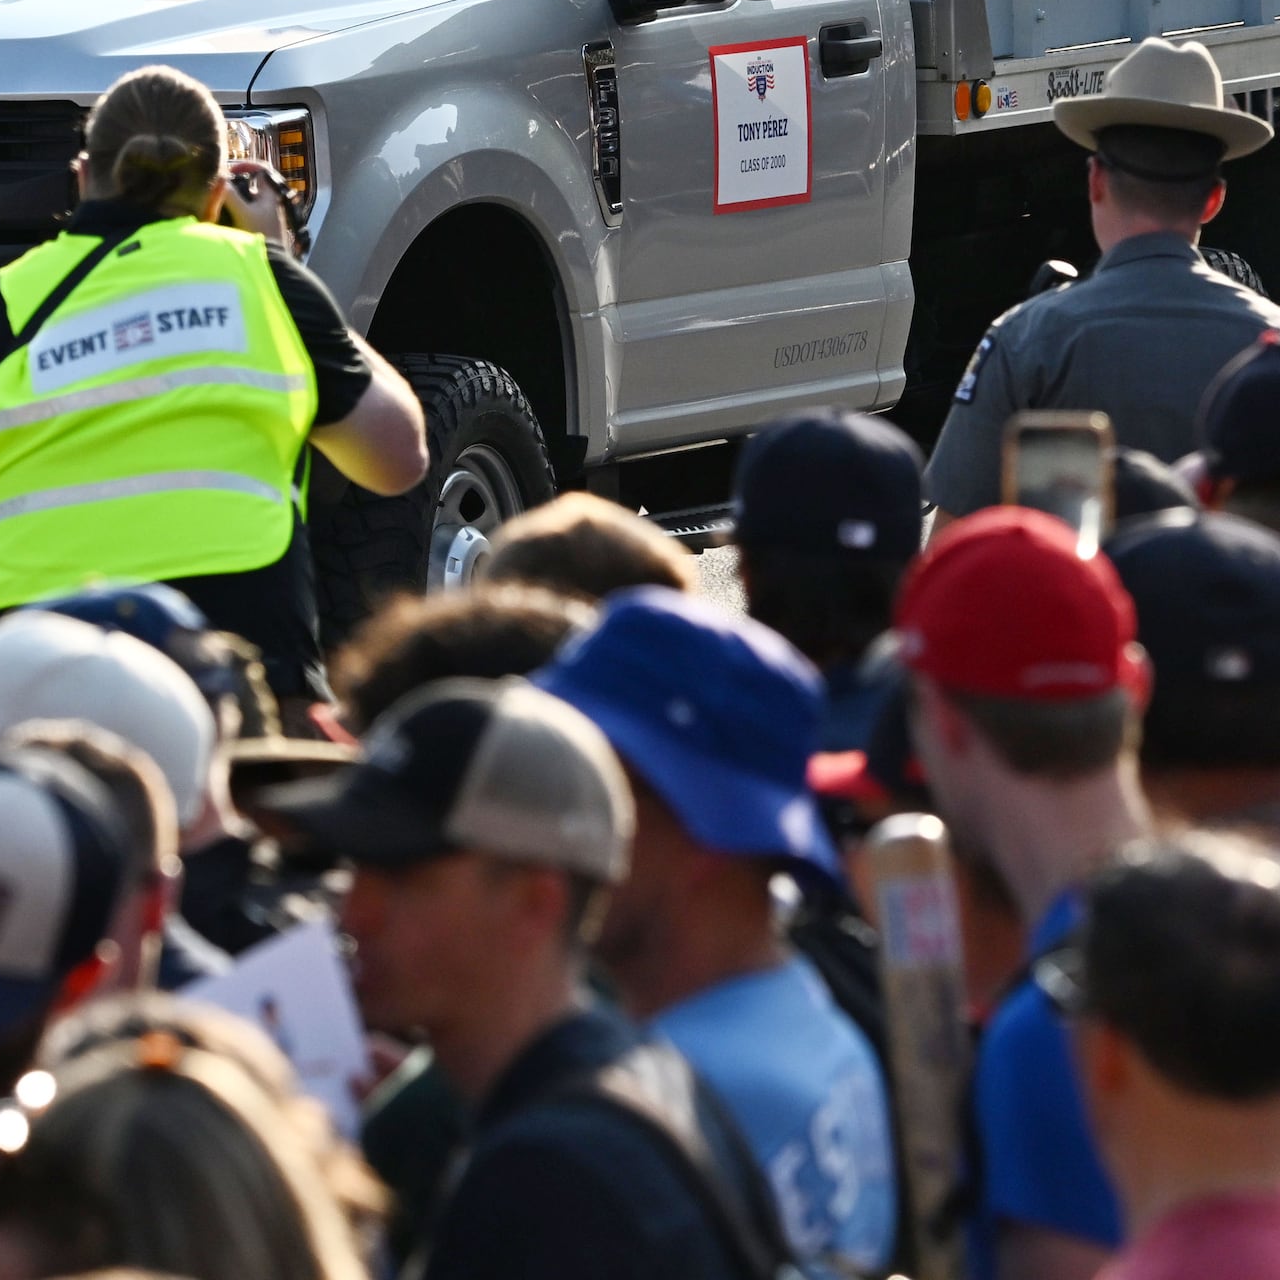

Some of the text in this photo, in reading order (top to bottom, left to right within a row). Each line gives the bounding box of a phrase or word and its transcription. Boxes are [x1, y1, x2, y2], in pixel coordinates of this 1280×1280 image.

[746, 63, 774, 75] INDUCTION
[737, 115, 789, 142] TONY PÉREZ
[740, 154, 787, 173] CLASS OF 2000
[36, 306, 229, 372] EVENT STAFF
[774, 329, 869, 369] USDOT4306778
